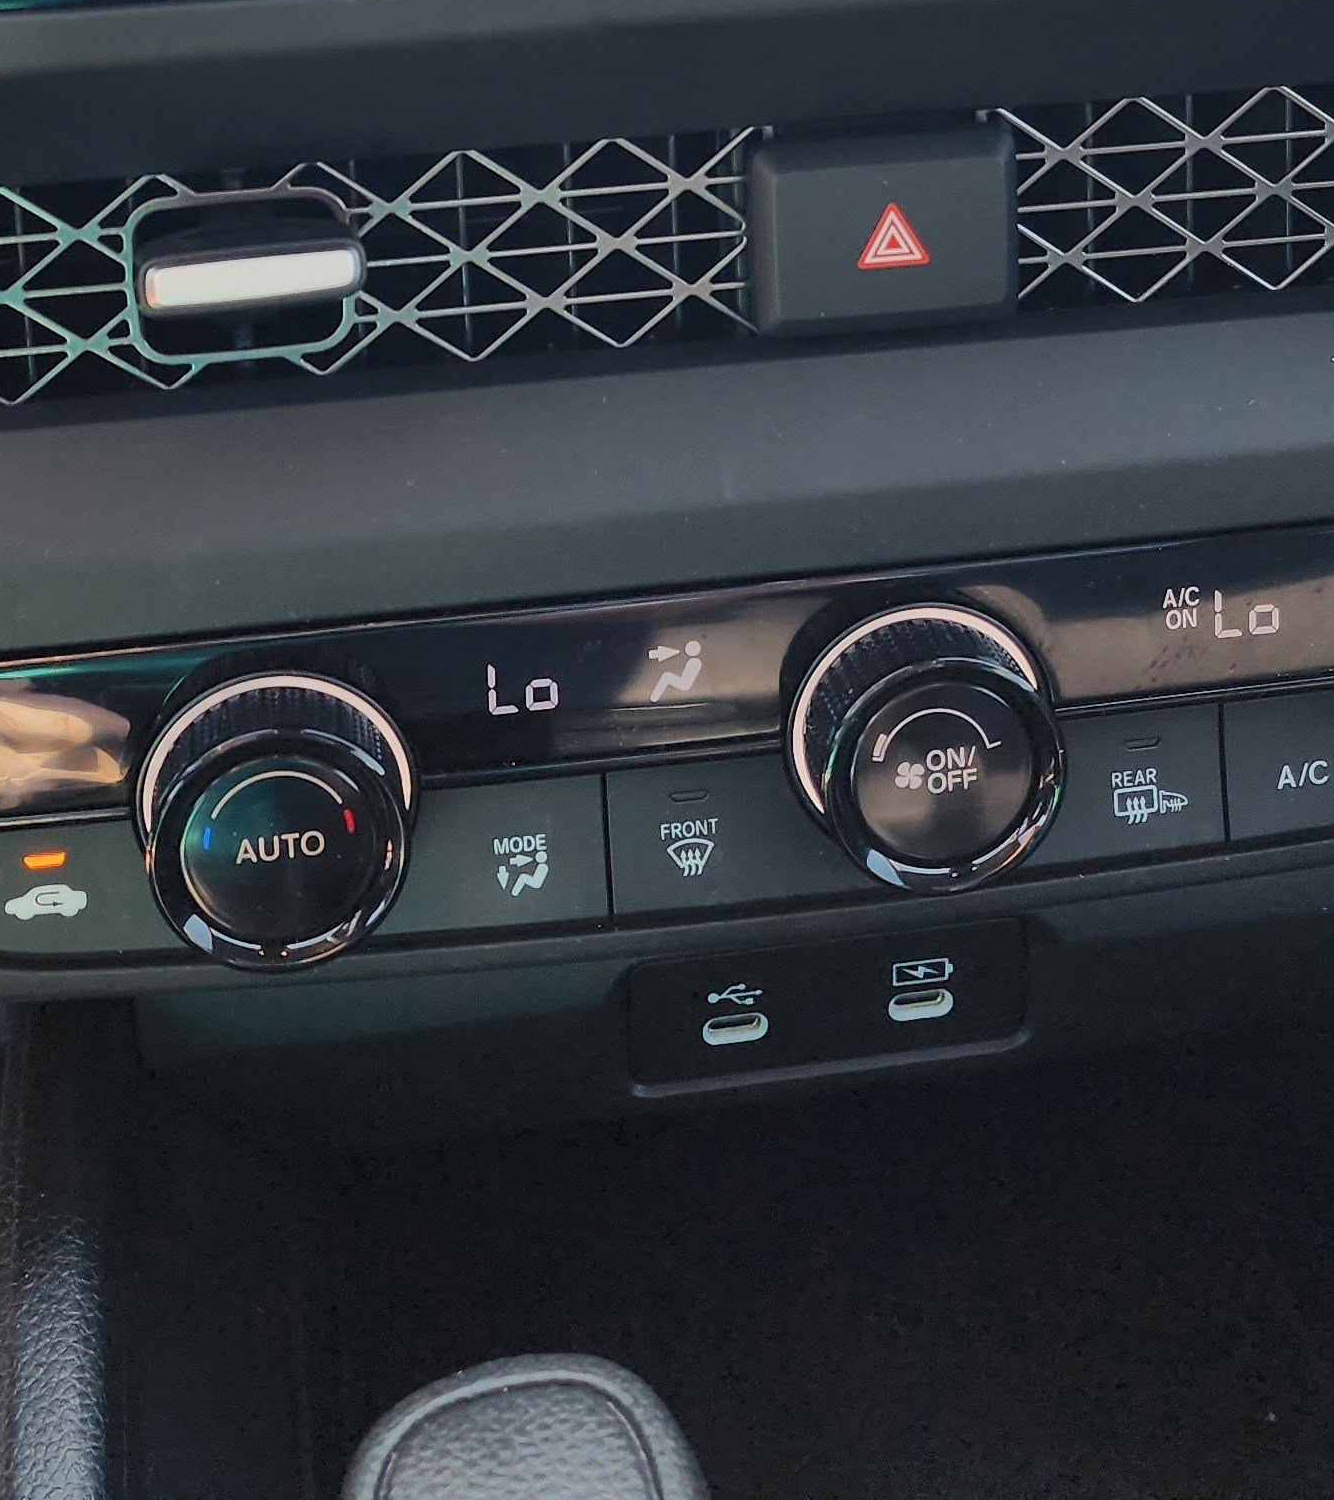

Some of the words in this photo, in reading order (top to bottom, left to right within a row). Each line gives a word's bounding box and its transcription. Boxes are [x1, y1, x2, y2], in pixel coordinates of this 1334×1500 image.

[1161, 586, 1201, 609] A/C
[1164, 608, 1199, 631] ON
[926, 769, 979, 796] OFF
[1110, 766, 1159, 788] REAR
[1276, 759, 1331, 791] A/C
[658, 816, 721, 842] FRONT
[234, 829, 327, 866] AUTO
[491, 832, 549, 856] MODE
